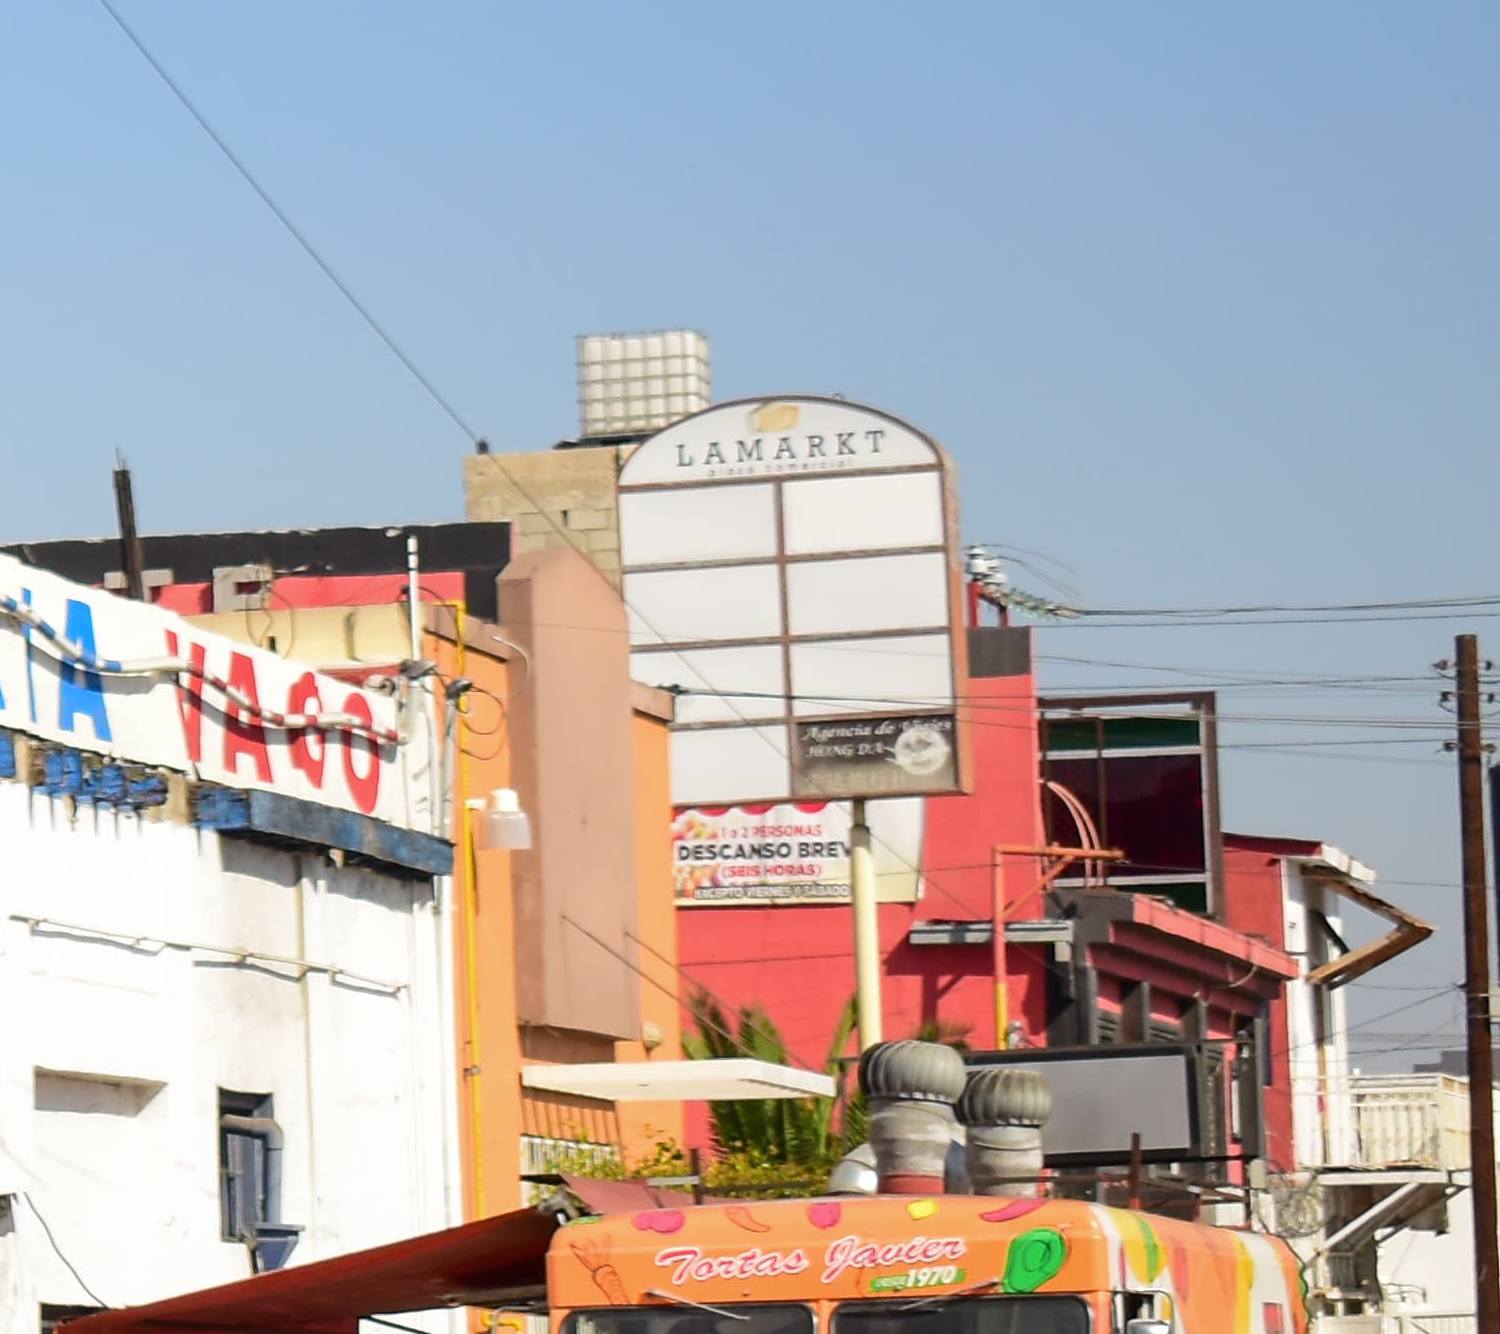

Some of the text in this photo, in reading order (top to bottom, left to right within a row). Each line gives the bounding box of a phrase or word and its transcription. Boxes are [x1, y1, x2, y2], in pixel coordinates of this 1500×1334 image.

[676, 430, 887, 467] LAMARKT
[164, 628, 380, 814] VAGO
[752, 824, 822, 838] PERSONAS
[678, 841, 792, 862] DESCANSO
[655, 1234, 967, 1285] Tortas Javier
[905, 1266, 956, 1288] 1970
